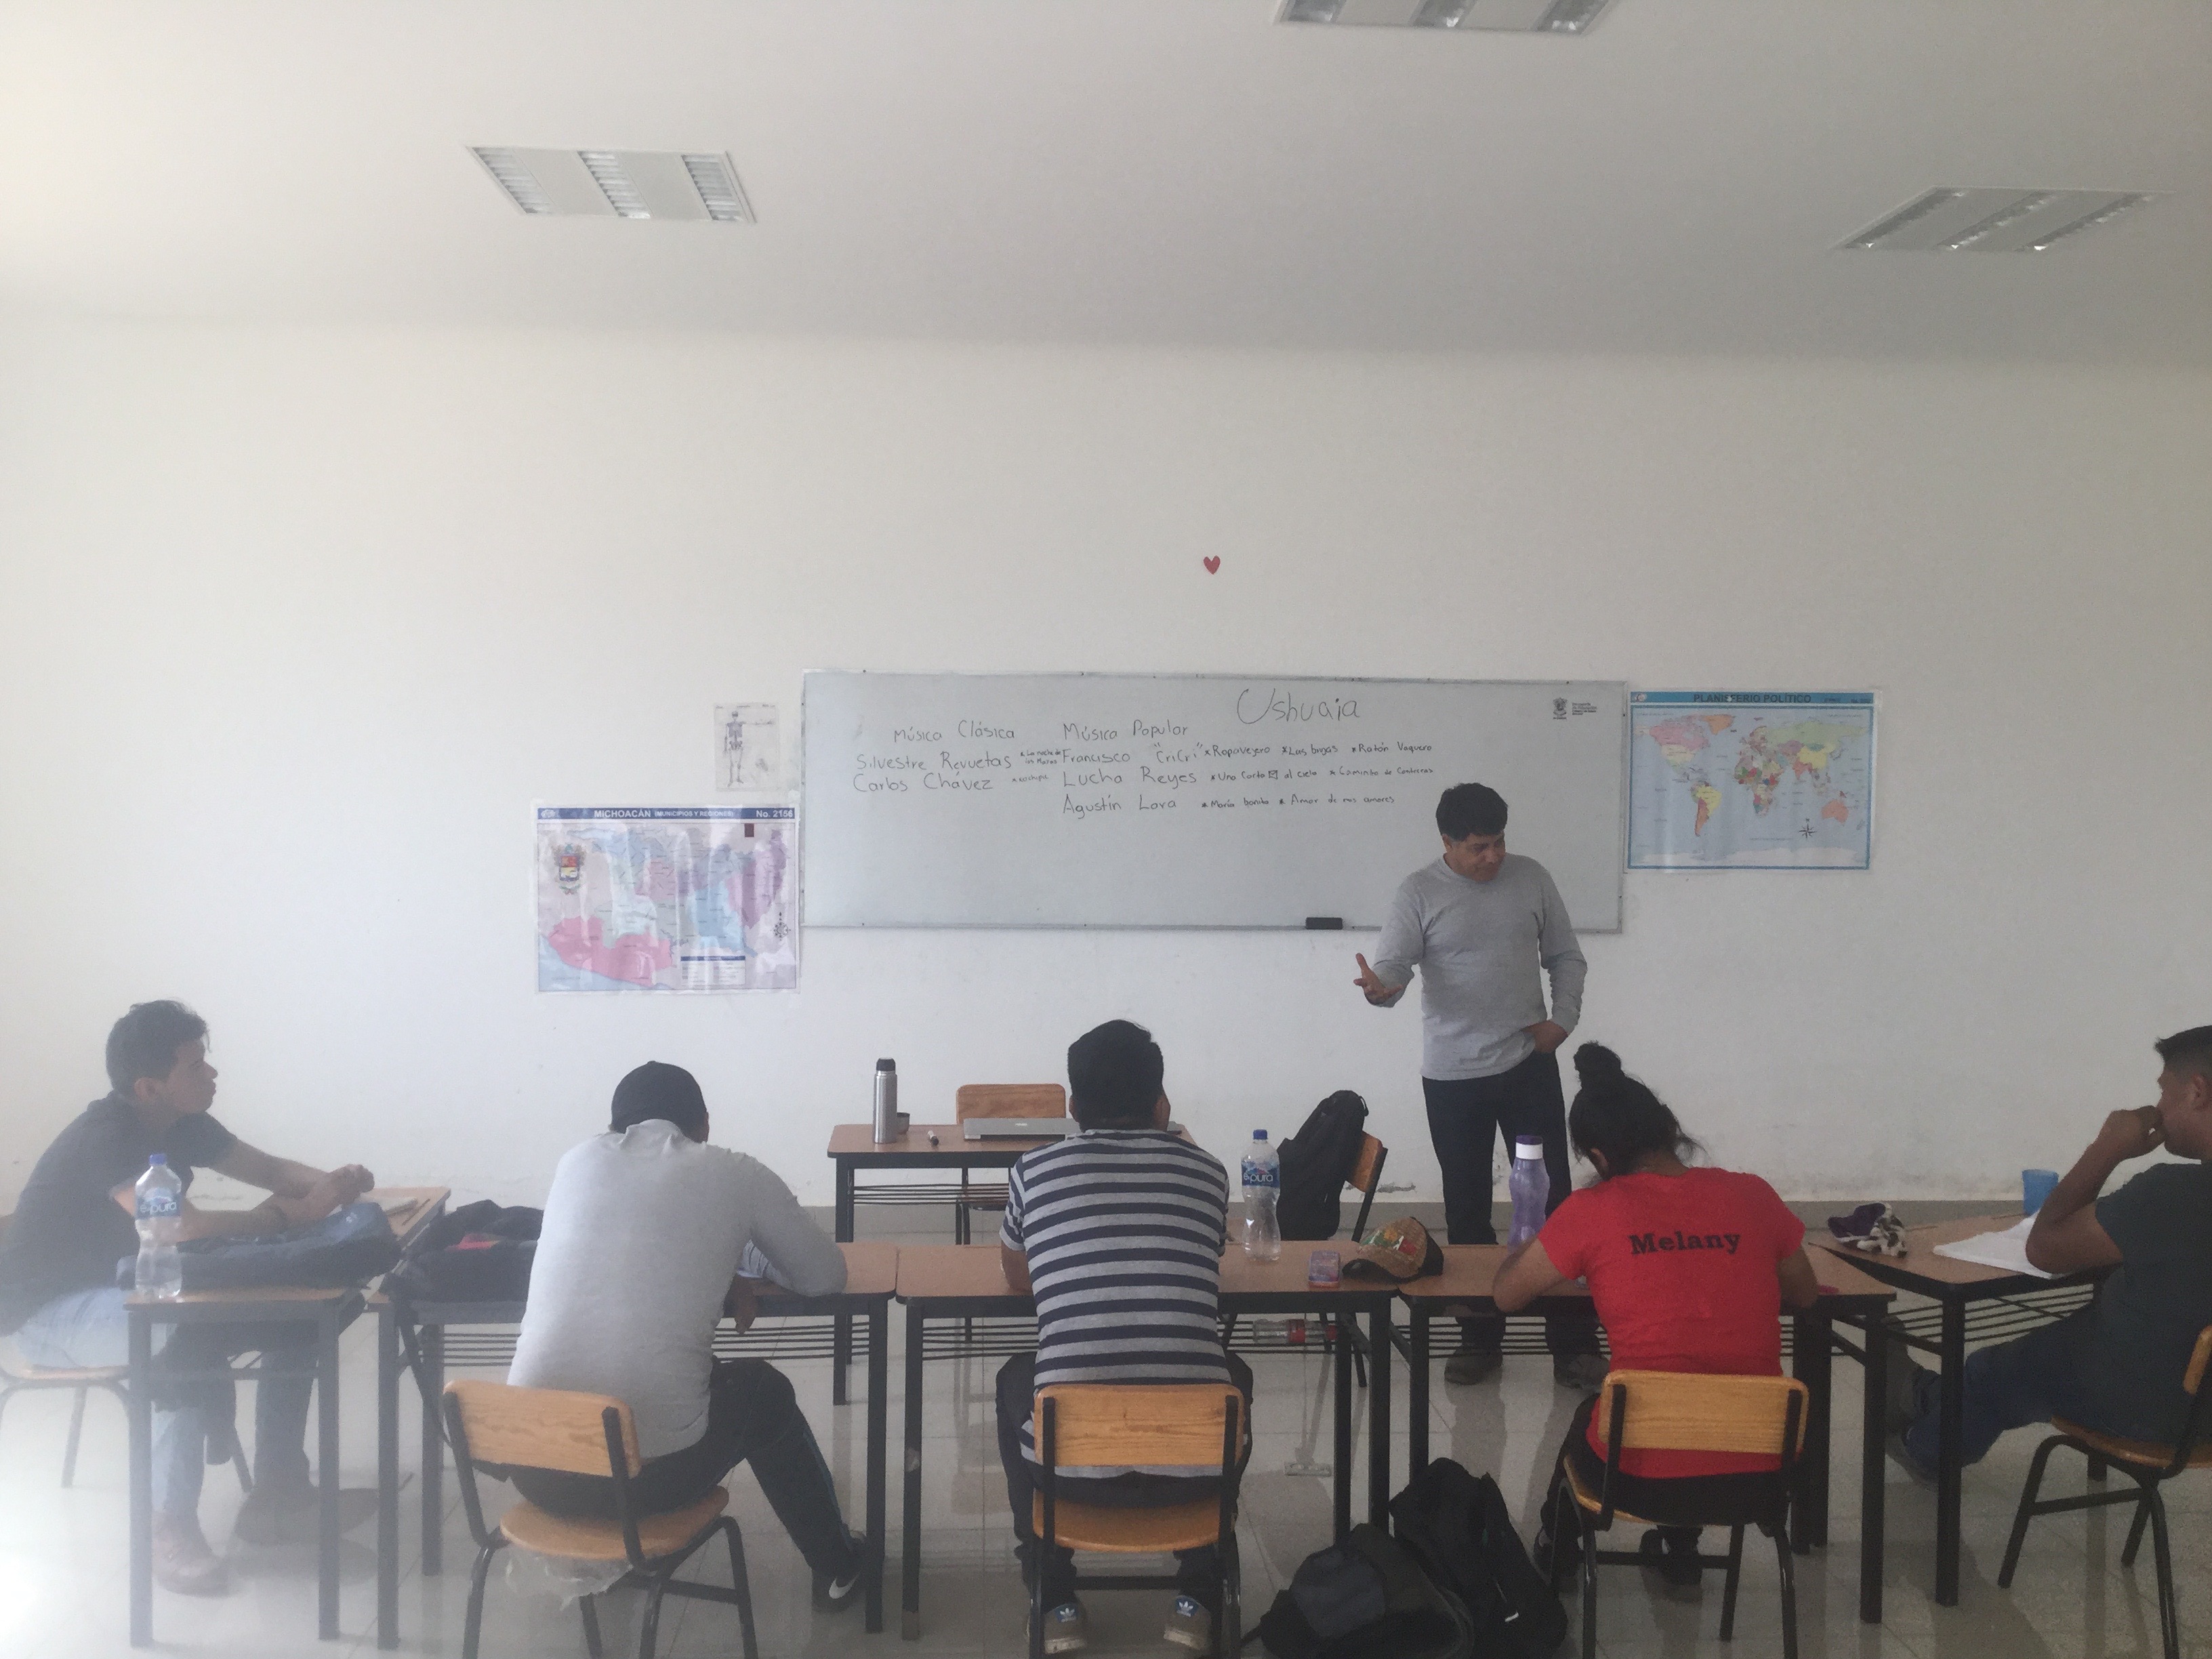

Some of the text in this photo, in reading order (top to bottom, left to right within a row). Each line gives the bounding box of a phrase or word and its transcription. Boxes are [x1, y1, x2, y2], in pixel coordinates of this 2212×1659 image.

[1237, 688, 1360, 724] Ushuaia
[1694, 693, 1811, 703] PLANISFERIO POLÍTICO
[894, 719, 1015, 743] Música Clásica
[1063, 719, 1188, 741] Música Popular
[1062, 748, 1130, 764] Francisco
[1397, 741, 1432, 754] Vaquero
[857, 754, 927, 771] Silvestre
[853, 771, 994, 792] Carlos Chávez
[1063, 768, 1122, 787] Lucha
[1140, 766, 1197, 790] Reyes
[1063, 793, 1122, 819] Agustín
[1290, 793, 1319, 806] Amor
[594, 808, 651, 818] MICHOACÁN
[756, 810, 771, 818] No.
[1629, 1231, 1741, 1254] Melany
